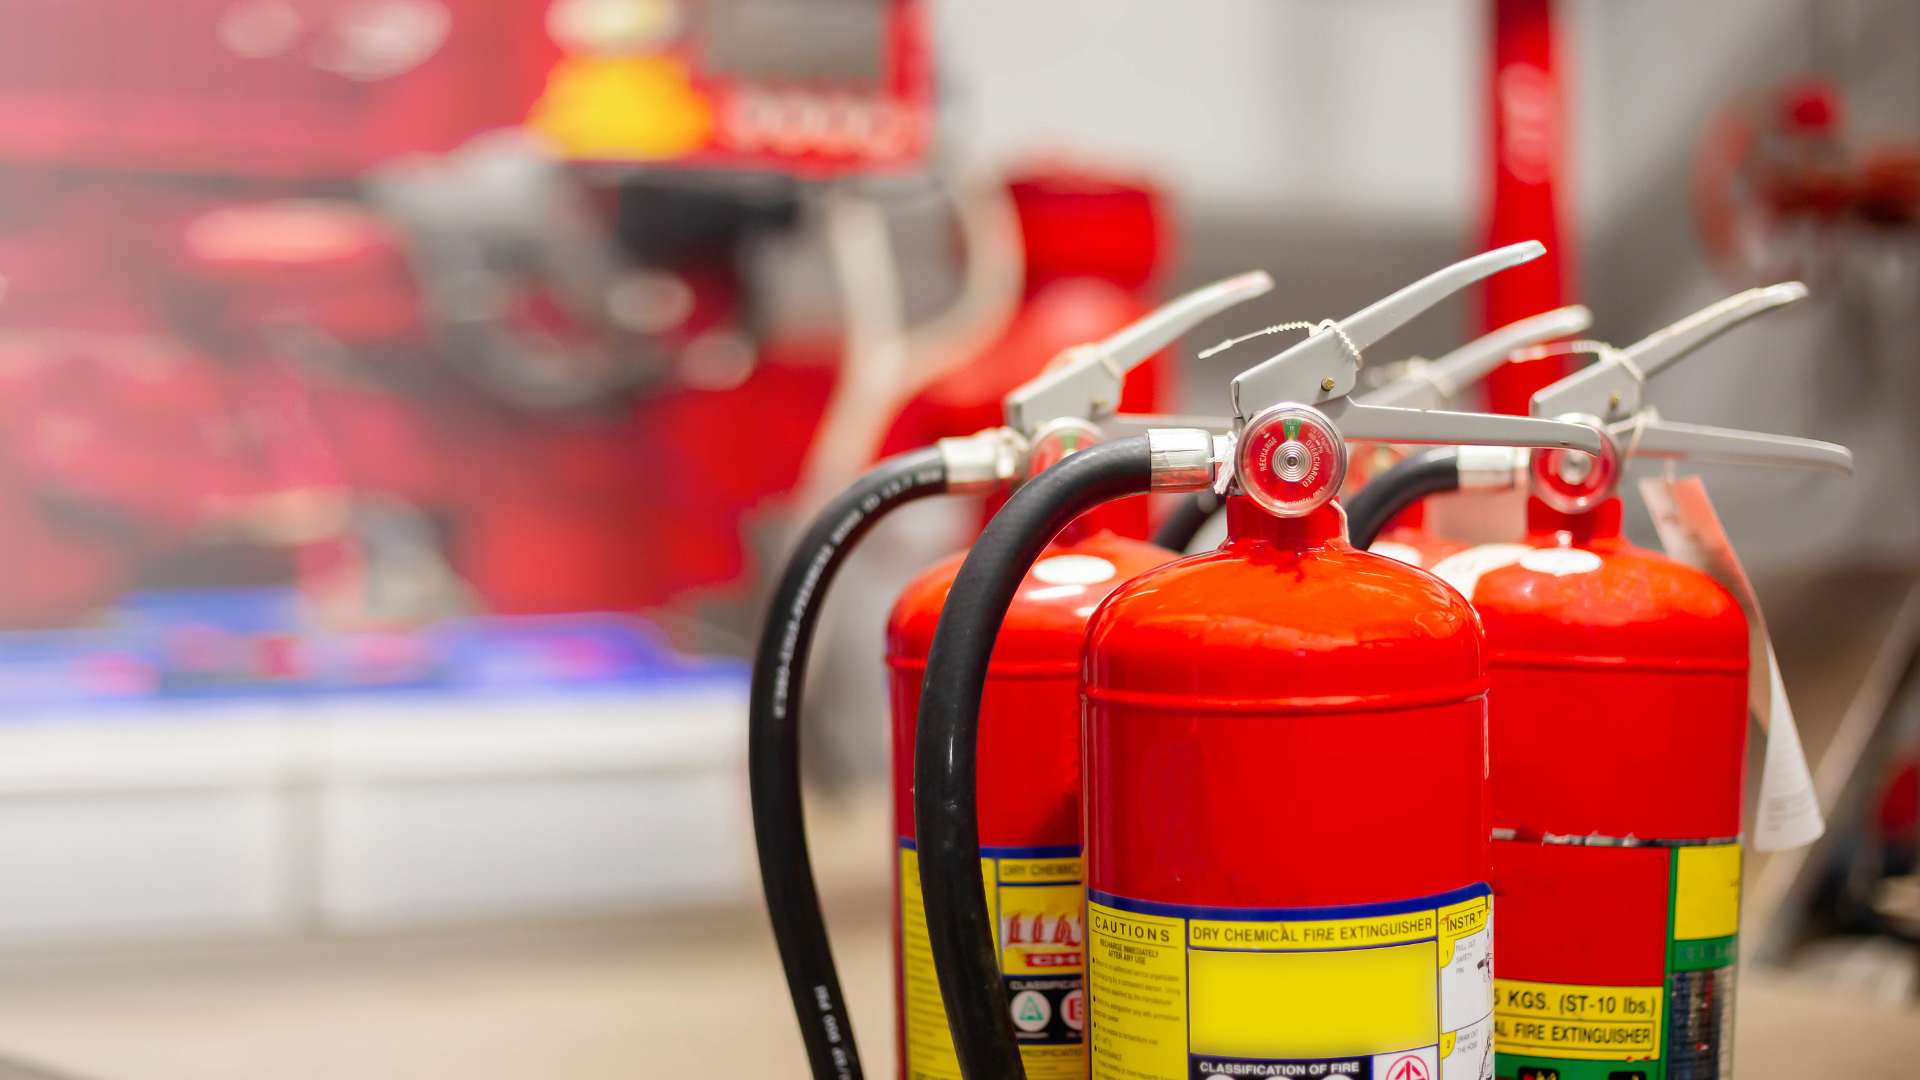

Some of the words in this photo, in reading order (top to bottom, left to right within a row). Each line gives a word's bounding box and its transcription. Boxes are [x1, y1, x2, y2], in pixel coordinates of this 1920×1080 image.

[1302, 439, 1321, 488] OVERCHARGED
[1095, 916, 1170, 943] CAUTIONS
[1193, 926, 1220, 941] DRY
[1224, 927, 1300, 943] CHEMICAL
[1303, 927, 1335, 942] FIRE
[1340, 916, 1433, 940] EXTINGUISHER
[1508, 990, 1551, 1011] KGS.
[1559, 994, 1617, 1016] (ST-10
[1622, 996, 1656, 1018] lbs.)
[1514, 1022, 1546, 1041] FIRE
[1551, 1025, 1651, 1045] EXTINGUISHER
[1199, 1061, 1307, 1077] CLASSIFICATION
[1309, 1063, 1328, 1075] OF
[1330, 1061, 1360, 1074] FIRE
